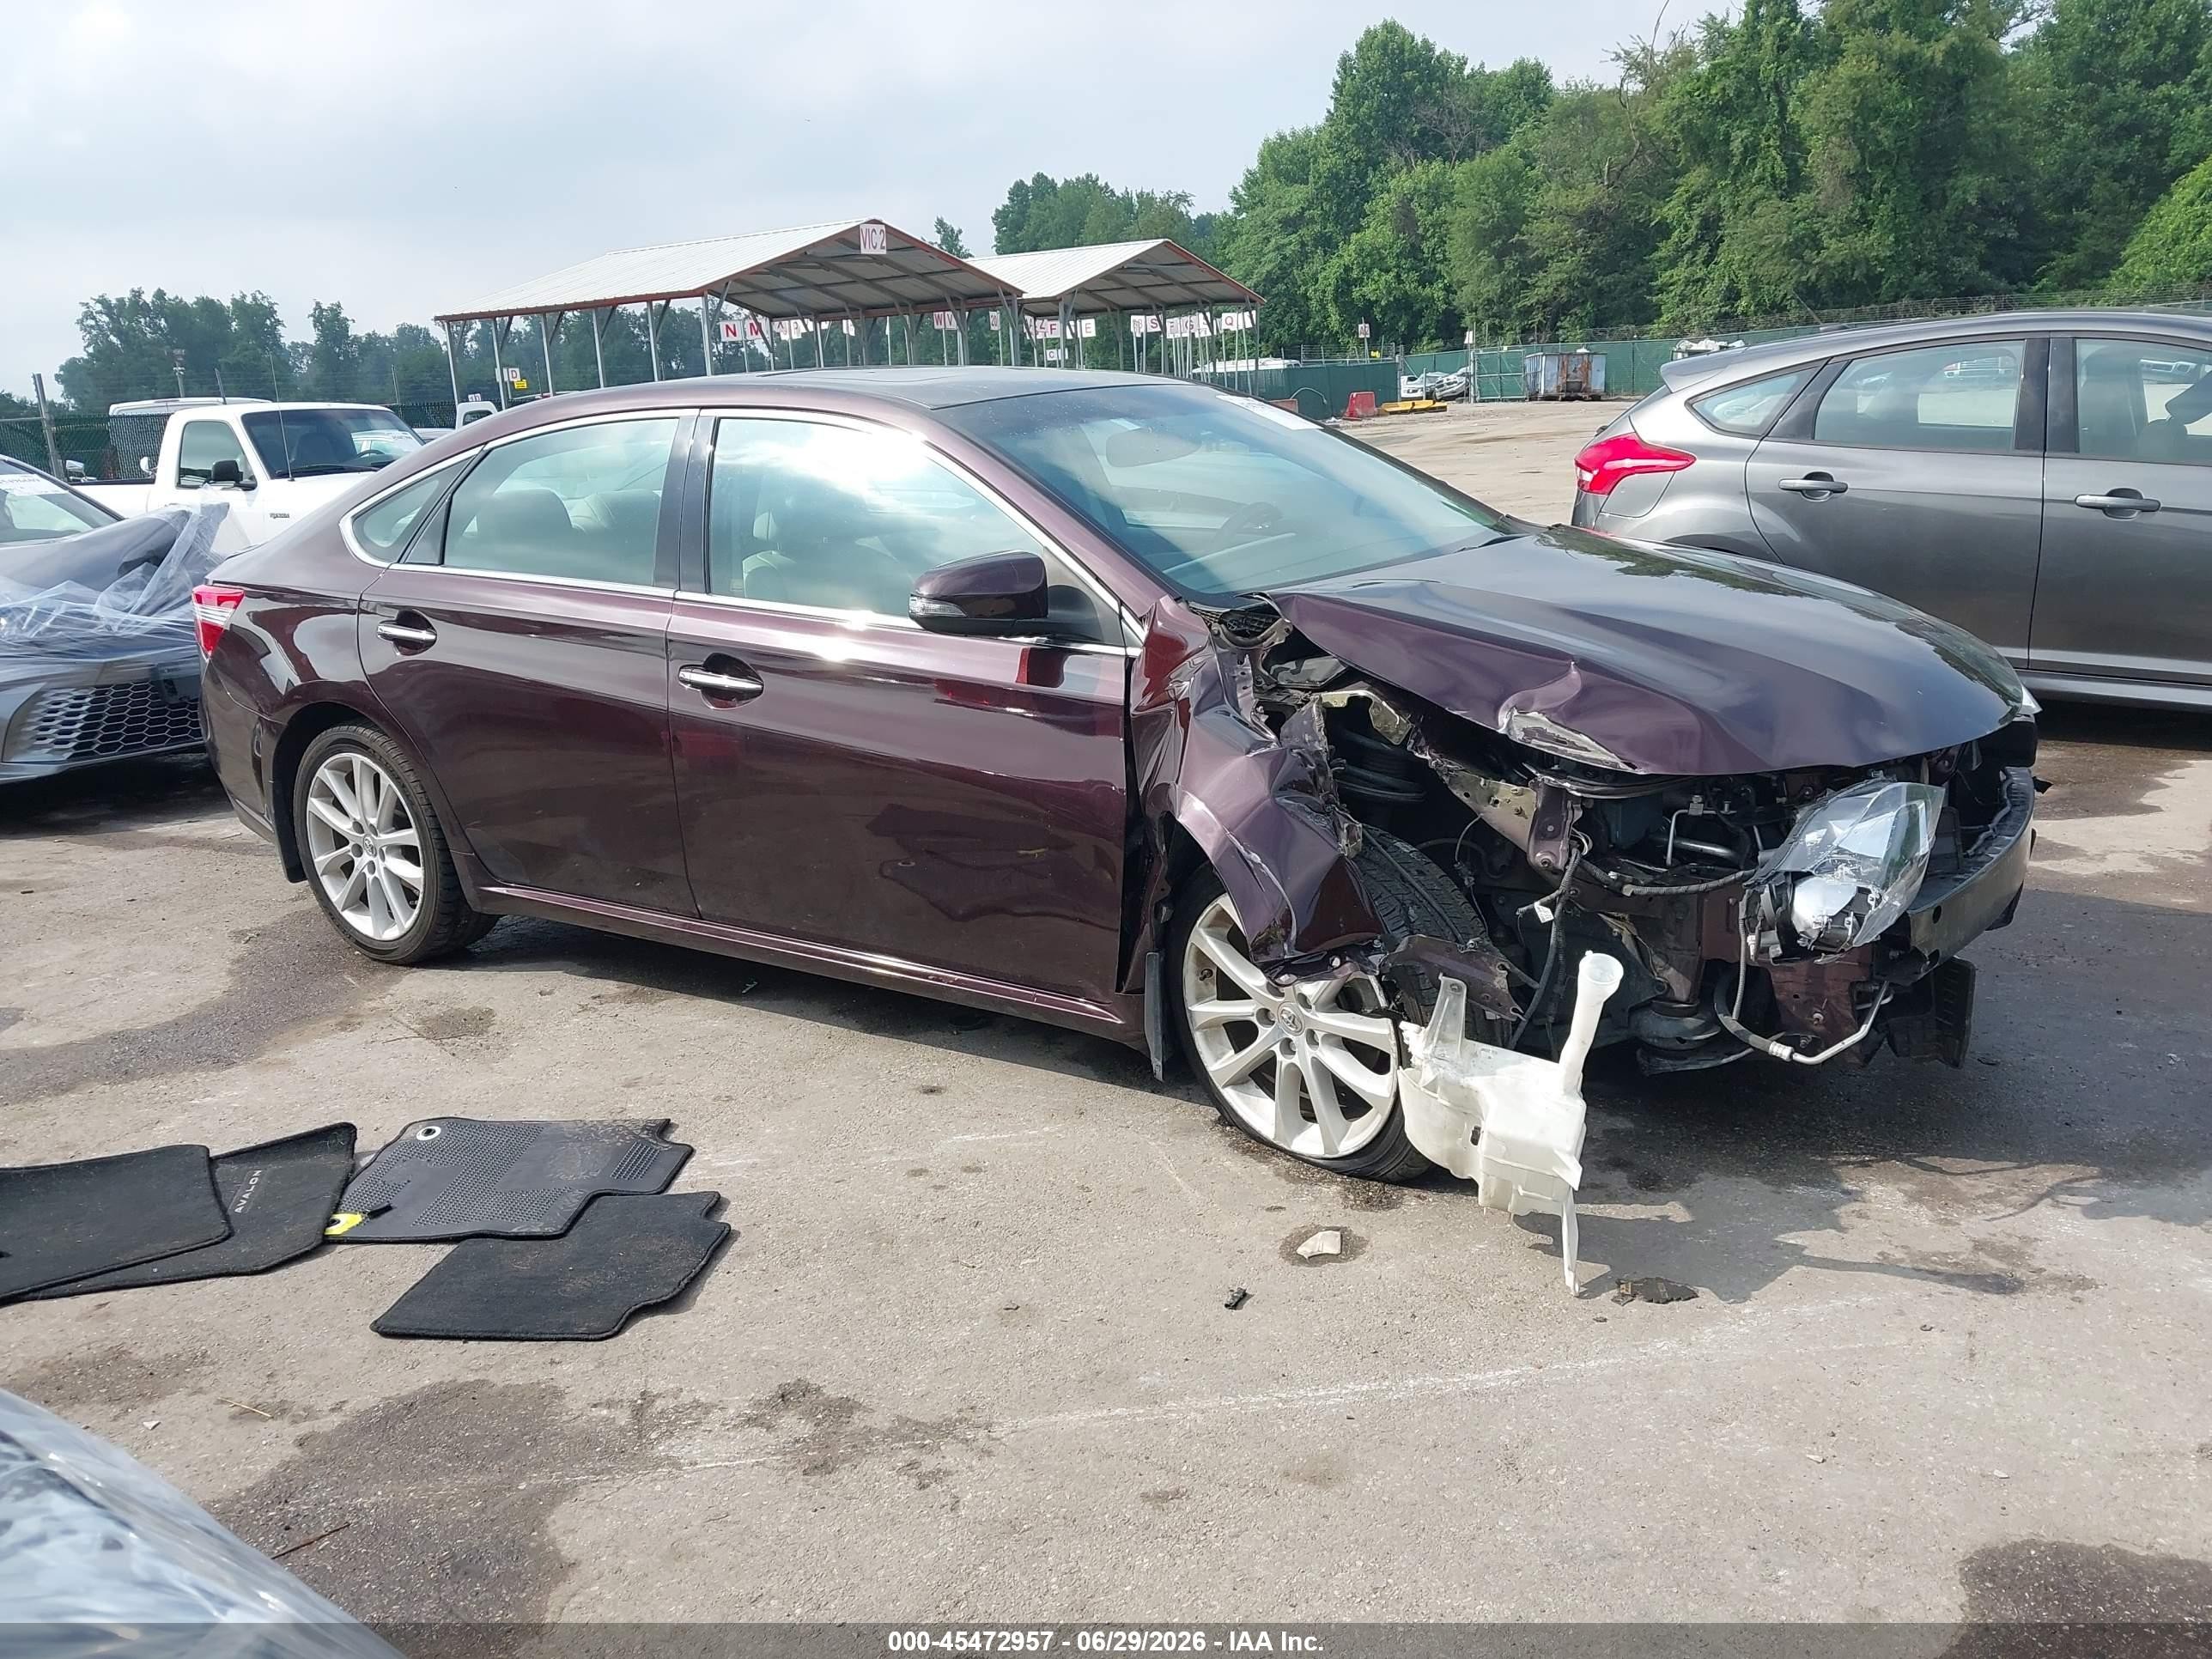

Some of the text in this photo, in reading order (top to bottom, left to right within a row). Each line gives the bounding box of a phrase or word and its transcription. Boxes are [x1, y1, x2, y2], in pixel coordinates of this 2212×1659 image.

[860, 228, 885, 249] VIC 2
[934, 313, 943, 326] W
[1151, 318, 1158, 329] S
[1224, 316, 1234, 326] Q
[725, 324, 738, 337] N
[1049, 323, 1057, 335] F
[1085, 323, 1091, 333] E
[511, 370, 518, 379] D
[234, 1170, 262, 1213] AVALON
